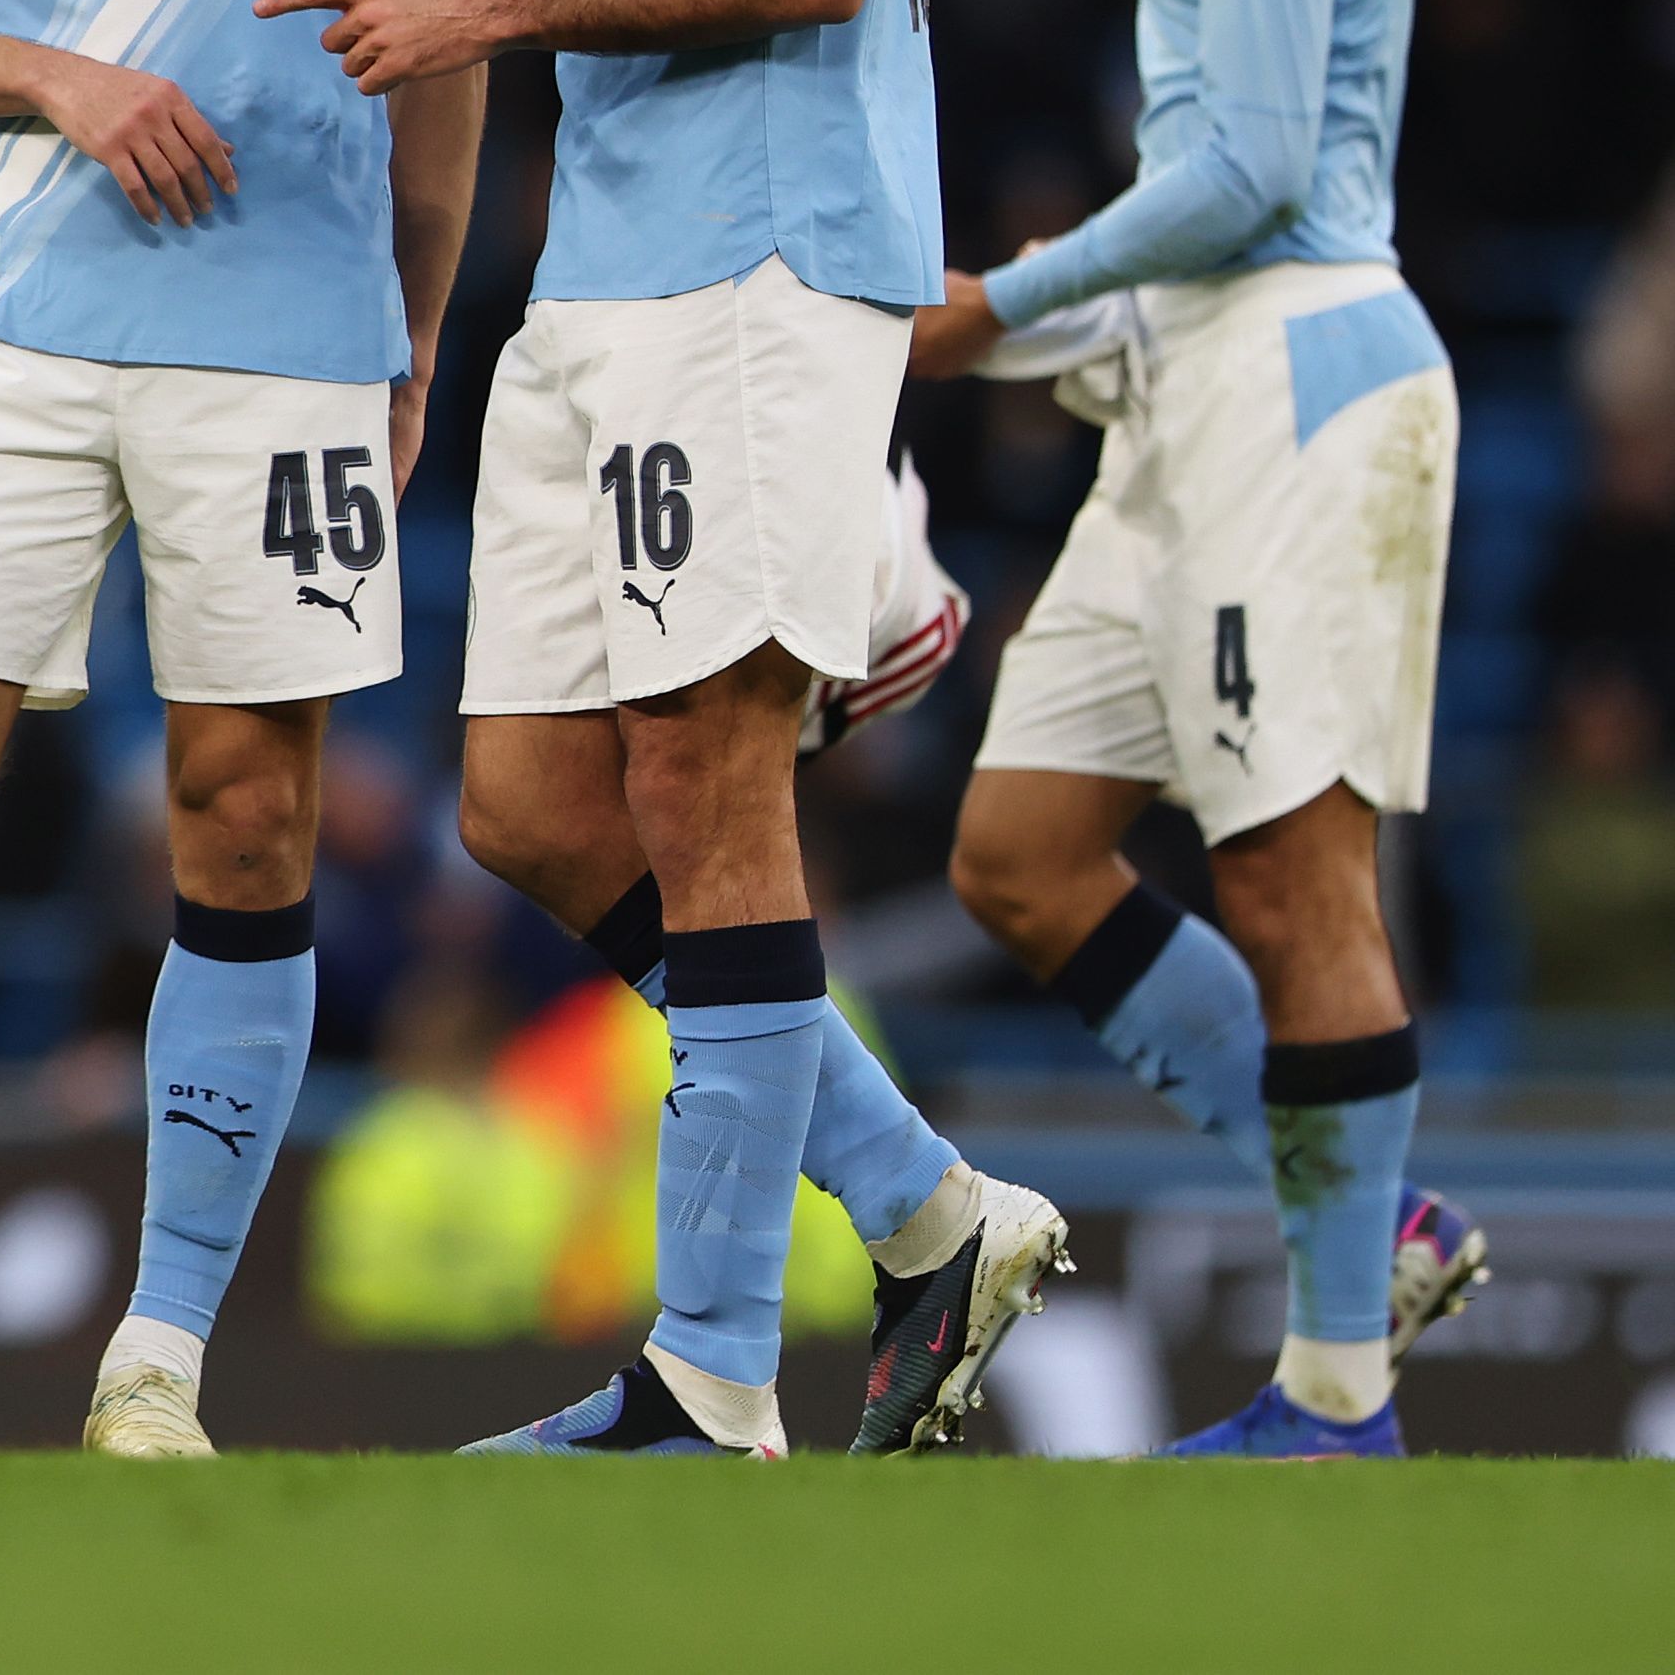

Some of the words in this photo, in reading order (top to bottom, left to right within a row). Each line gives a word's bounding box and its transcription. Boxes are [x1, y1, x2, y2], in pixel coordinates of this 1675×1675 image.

[262, 445, 386, 576] 45
[599, 441, 693, 571] 16
[1215, 605, 1256, 718] 4
